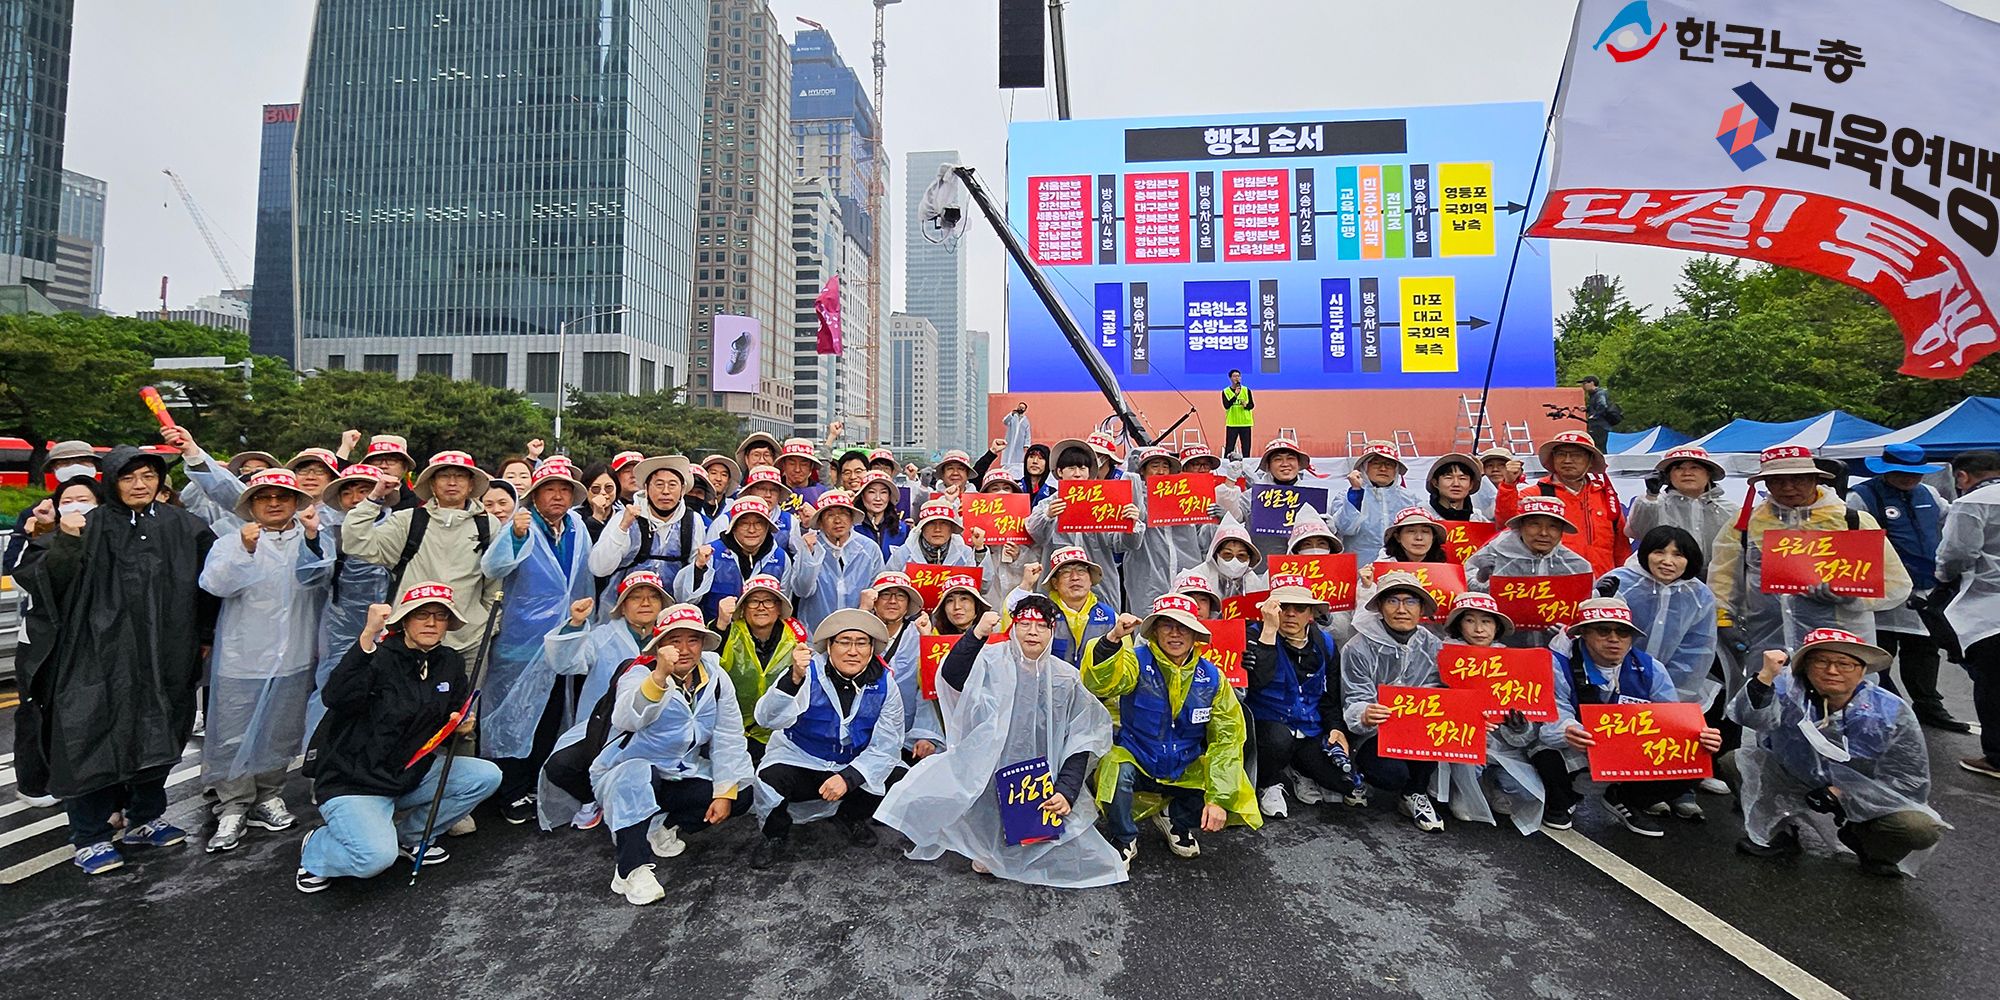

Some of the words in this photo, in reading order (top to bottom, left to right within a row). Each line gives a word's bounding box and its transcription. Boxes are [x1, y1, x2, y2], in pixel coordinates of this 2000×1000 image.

[1675, 16, 1867, 84] 한국노총
[1204, 127, 1260, 156] 행진
[1268, 125, 1324, 153] 순서
[1134, 179, 1180, 190] 강원본부
[1232, 176, 1279, 188] 법원본부
[1775, 101, 2000, 258] 교육연맹
[1232, 189, 1279, 202] 소방본부
[1444, 186, 1488, 199] 영등포
[1134, 202, 1180, 212] 대구본부
[1199, 185, 1212, 249] 방송차3호
[1233, 203, 1280, 215] 대학본부
[1299, 182, 1313, 246] 방송차2호
[1340, 187, 1356, 239] 교육연맹
[1363, 177, 1379, 247] 민주우체국
[1386, 192, 1402, 231] 전교조
[1413, 178, 1429, 244] 방송차1호
[1445, 202, 1488, 215] 국회역
[1101, 188, 1114, 251] 방송차4호
[1233, 216, 1280, 228] 국회본부
[1452, 219, 1482, 232] 남측
[1228, 243, 1286, 256] 교육청본부
[1553, 189, 1807, 250] 단결!
[1819, 206, 1998, 369] 투쟁!
[1188, 301, 1248, 317] 교육청노조
[1412, 294, 1442, 306] 마포
[1133, 296, 1146, 360] 방송차7호
[1188, 319, 1249, 334] 소방노조
[1262, 294, 1276, 359] 방송차6호
[1329, 293, 1345, 358] 시군구연맹
[1363, 292, 1378, 358] 방송차5호
[1413, 310, 1443, 323] 대교
[1102, 309, 1117, 348] 국공노
[1407, 327, 1450, 339] 국회역
[1188, 335, 1249, 351] 광역연맹
[1414, 343, 1444, 356] 북측
[1064, 484, 1105, 504] 우리도
[1153, 478, 1191, 498] 우리도
[1257, 487, 1301, 509] 생존권
[968, 497, 1006, 517] 우리도
[1771, 536, 1837, 558] 우리도
[1814, 558, 1872, 583] 정치!
[1498, 581, 1556, 601] 우리도
[1450, 655, 1508, 680] 우리도
[1490, 680, 1542, 706] 정치!
[1387, 694, 1445, 718] 우리도
[1426, 720, 1476, 747] 정치!
[1594, 710, 1660, 739] 우리도
[1641, 737, 1699, 766] 정치!
